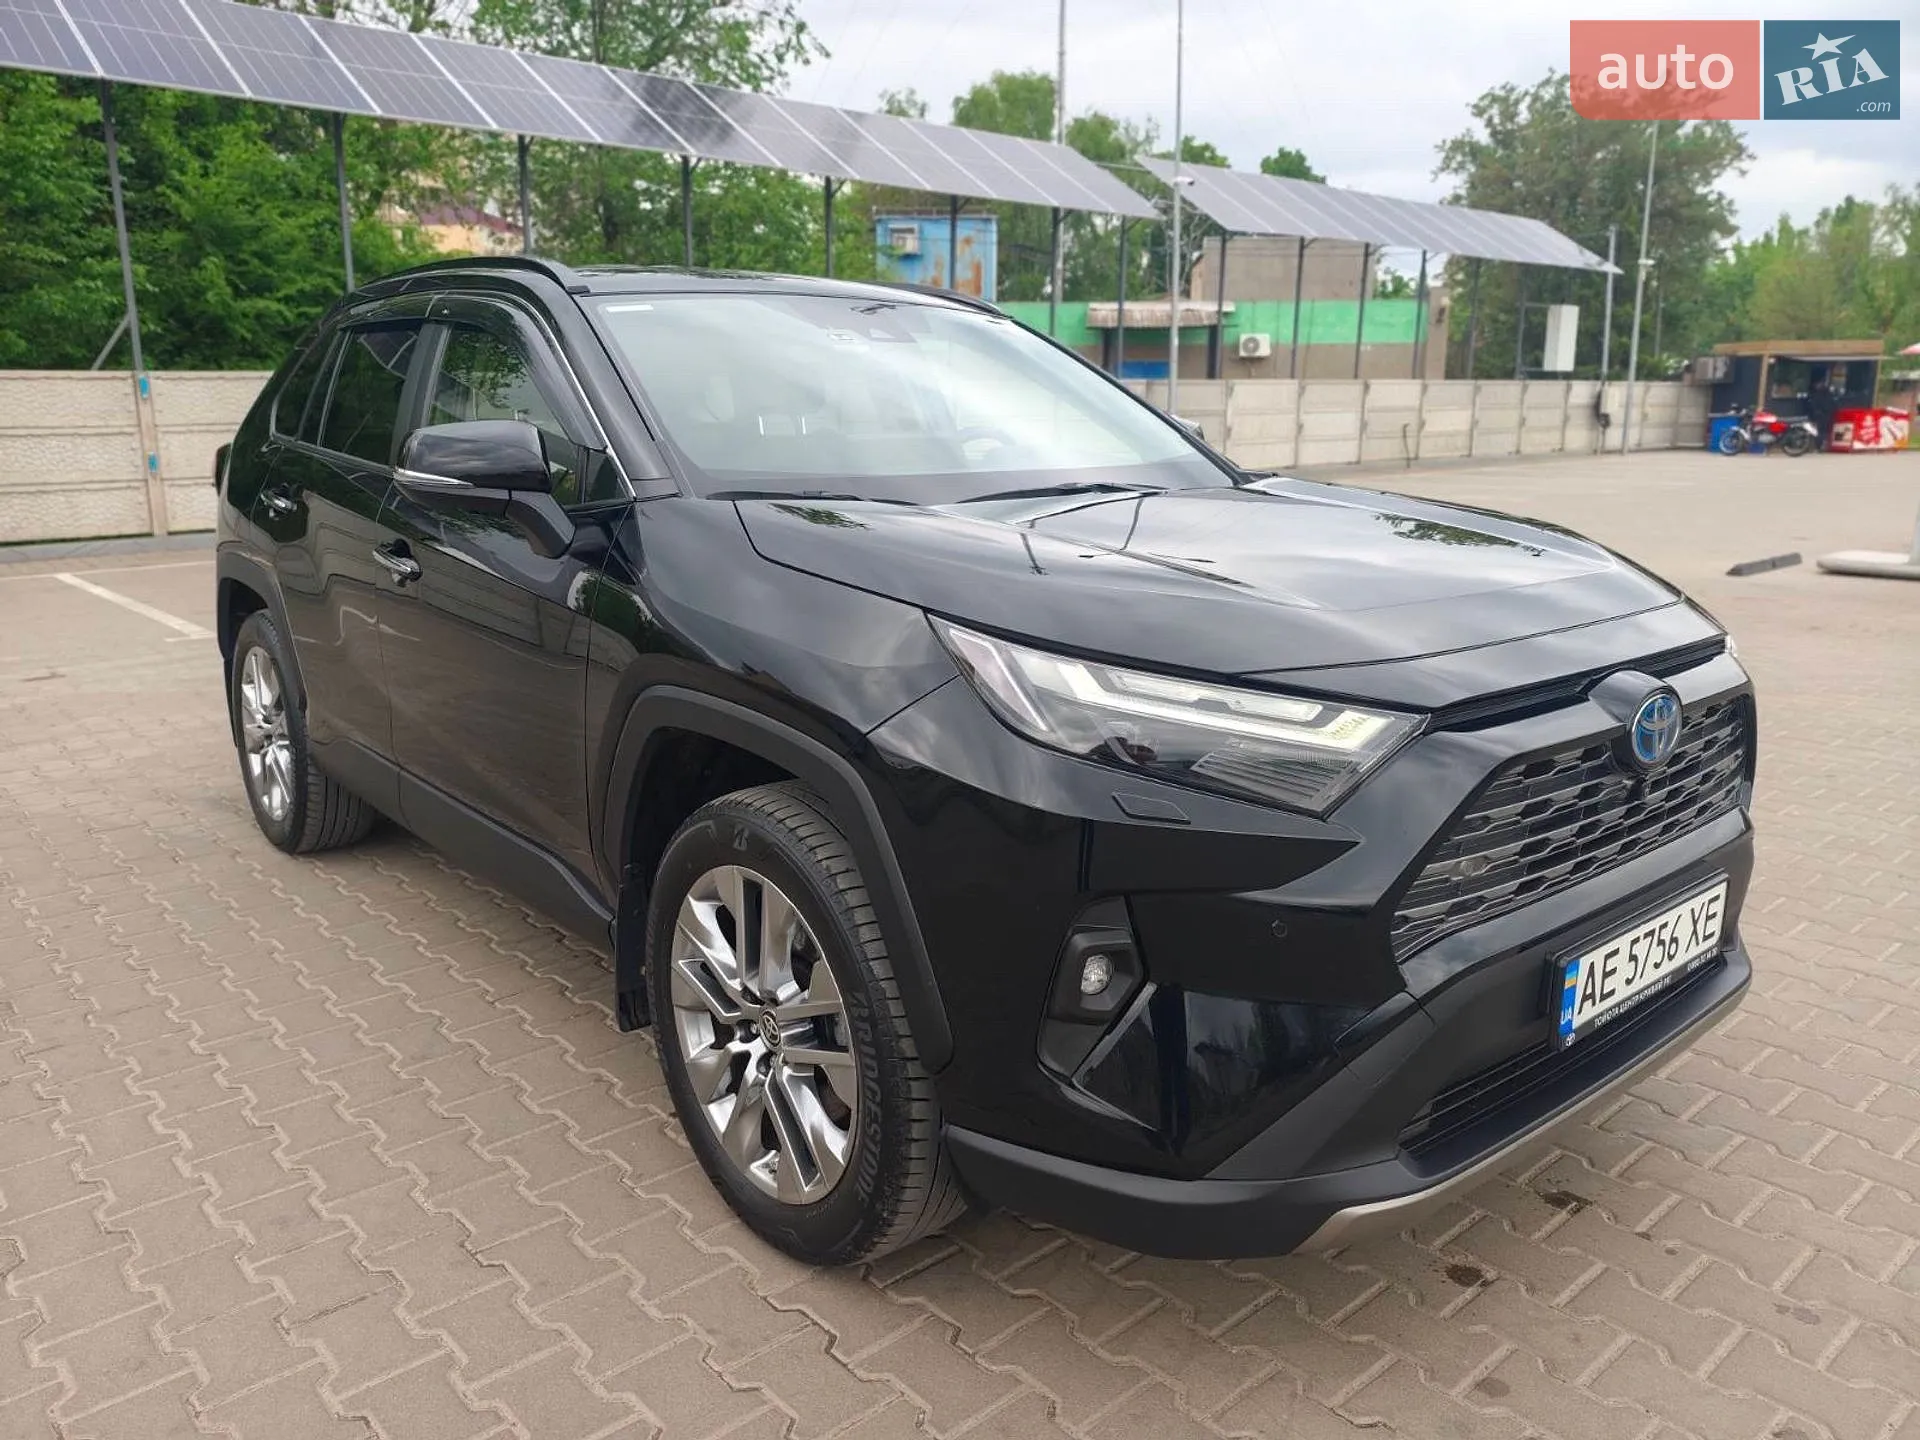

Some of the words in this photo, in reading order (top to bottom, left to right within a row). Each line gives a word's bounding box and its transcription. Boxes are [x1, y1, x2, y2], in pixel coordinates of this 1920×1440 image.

[1559, 1006, 1573, 1025] UA
[1578, 947, 1620, 1016] AE
[1625, 913, 1682, 986] 5756
[1685, 893, 1720, 953] XE
[850, 990, 882, 1209] BRIDGESTONE
